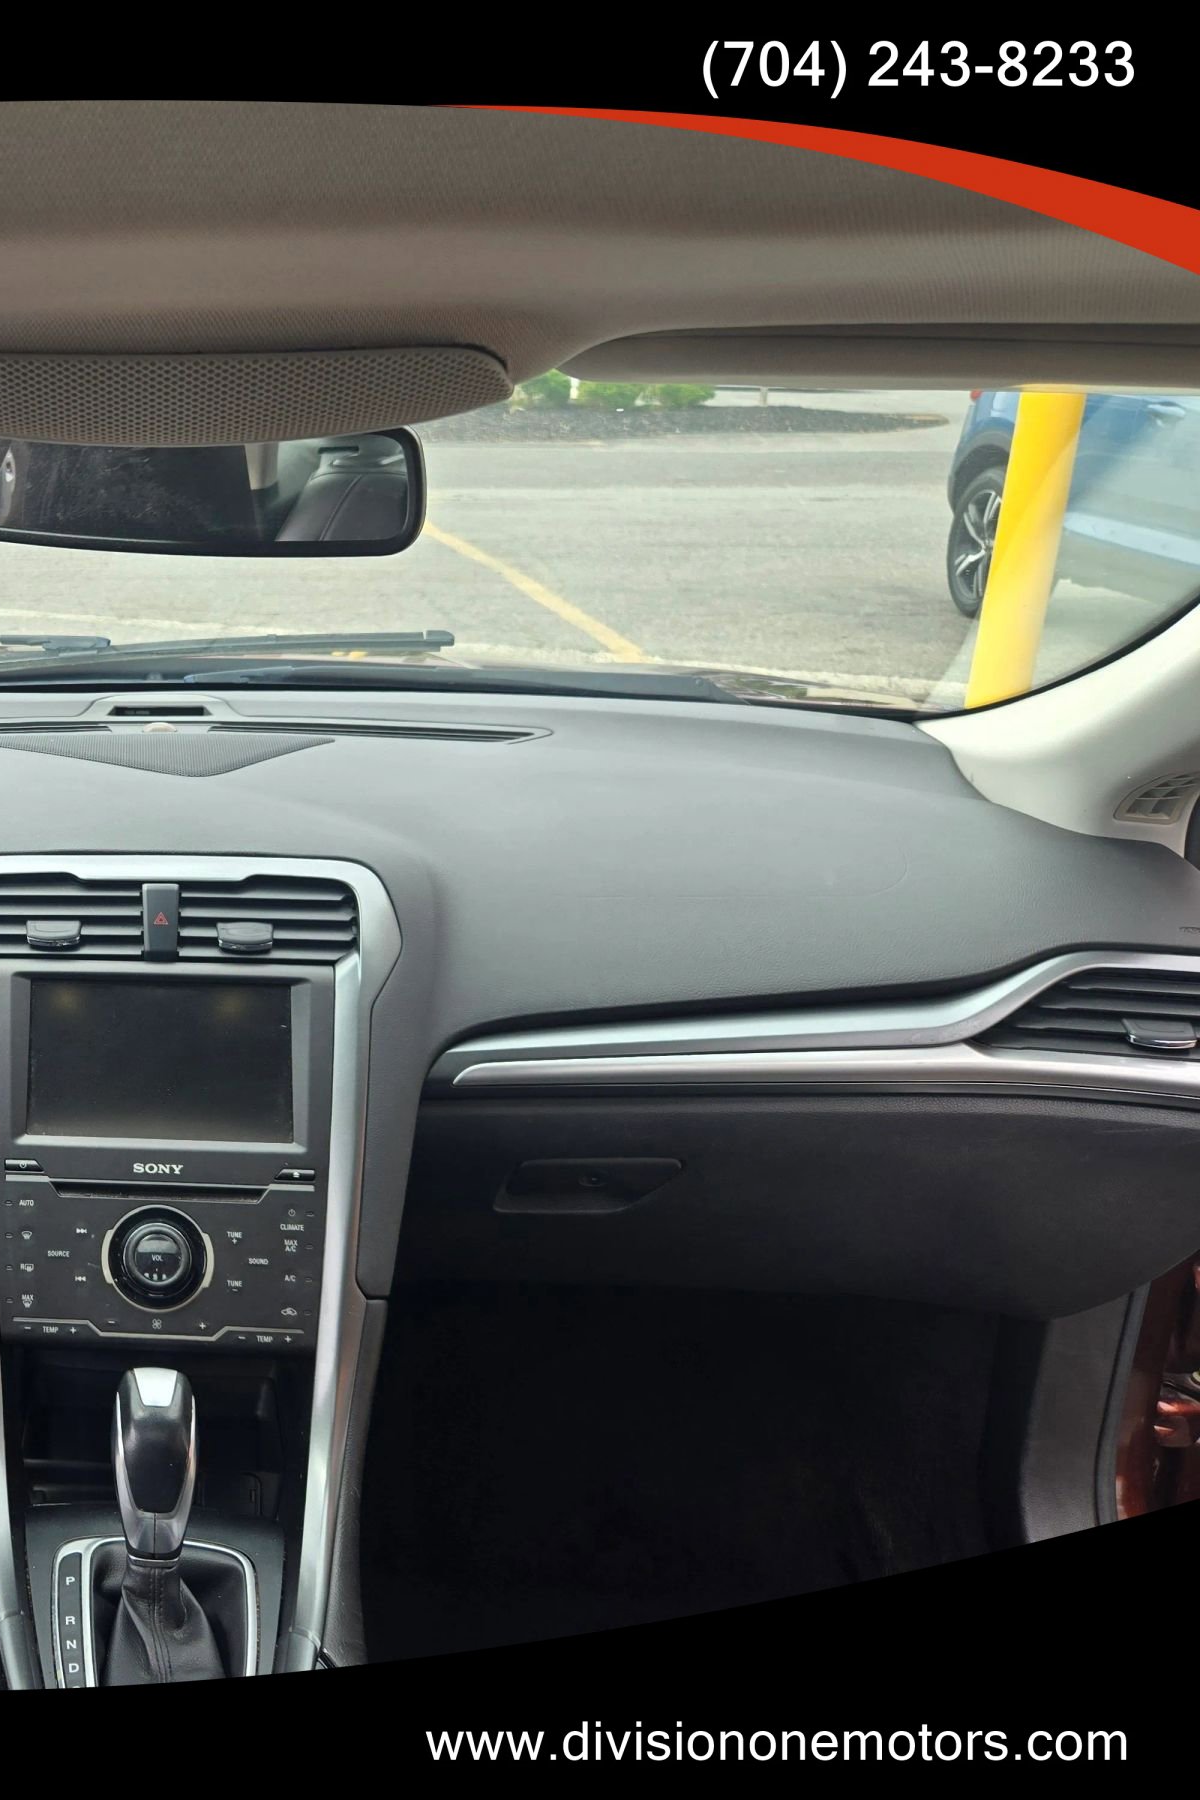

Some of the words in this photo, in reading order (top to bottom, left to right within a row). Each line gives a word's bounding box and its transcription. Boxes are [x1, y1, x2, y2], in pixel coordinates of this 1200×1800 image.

[132, 1162, 184, 1175] SONY
[19, 1199, 35, 1207] AUTO
[280, 1223, 305, 1231] CLIMATE
[226, 1231, 243, 1239] TUNE
[47, 1250, 70, 1258] SOURCE
[151, 1254, 164, 1262] VOL
[284, 1274, 296, 1282] A/C
[42, 1325, 59, 1334] TEMP
[256, 1335, 274, 1343] TEMP
[65, 1576, 76, 1586] P
[65, 1615, 76, 1625] R
[66, 1639, 77, 1650] N
[68, 1663, 80, 1673] D
